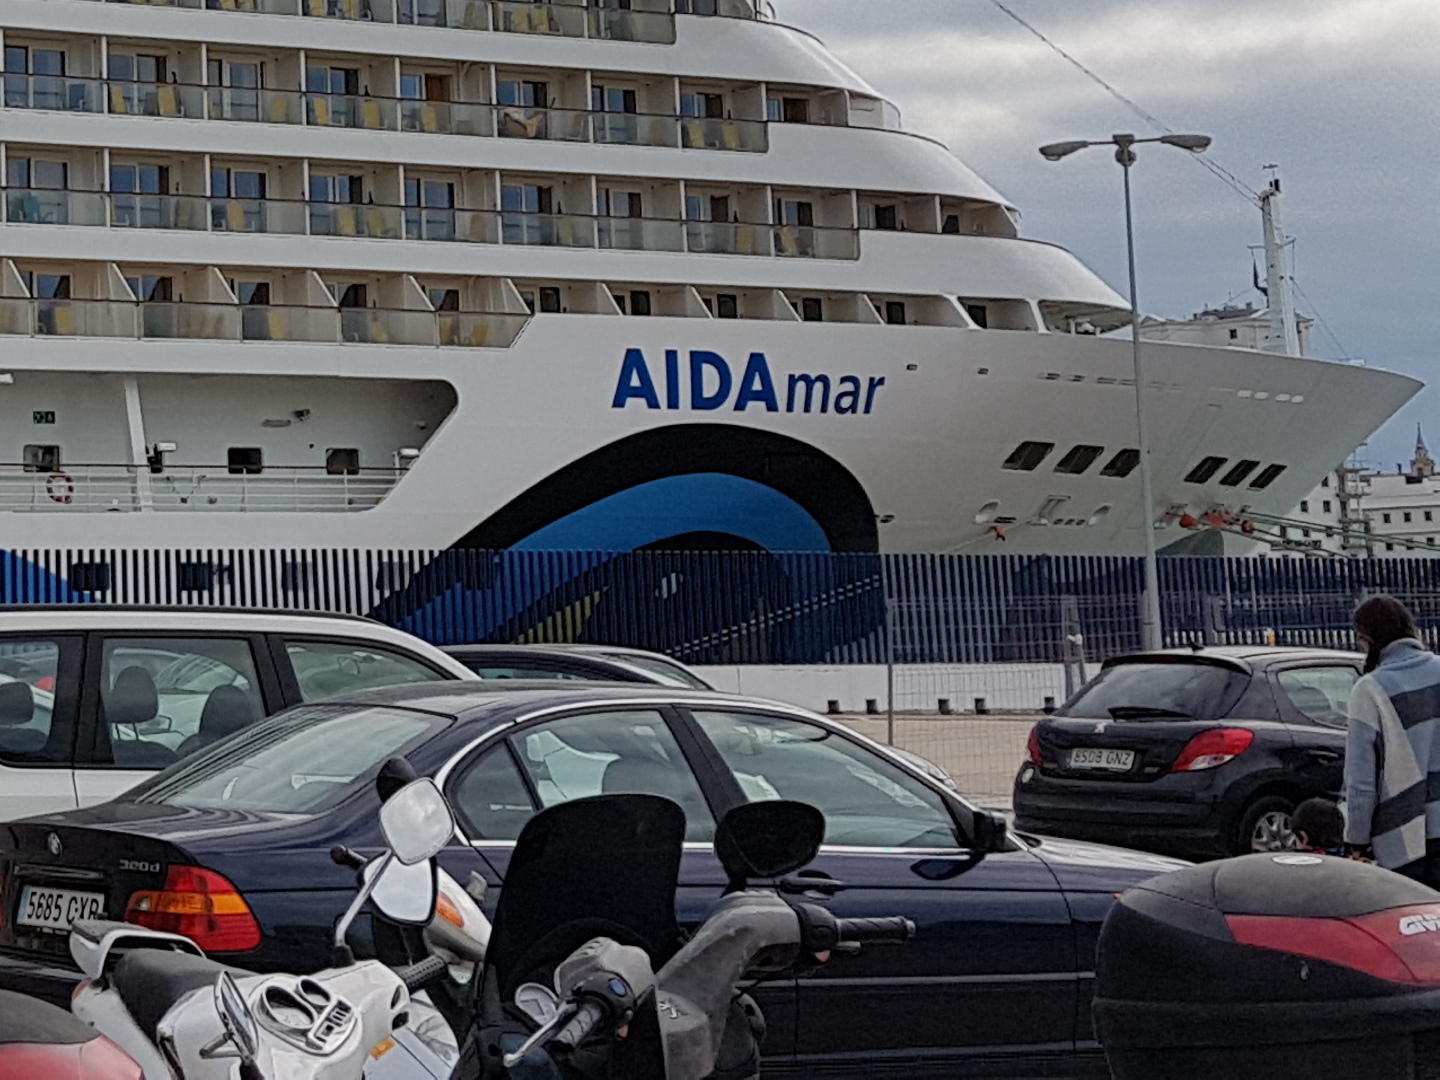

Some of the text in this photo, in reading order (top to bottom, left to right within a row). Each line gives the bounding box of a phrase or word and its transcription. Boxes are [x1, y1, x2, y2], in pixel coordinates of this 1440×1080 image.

[611, 348, 886, 415] AIDAmar
[1105, 751, 1131, 766] GNZ
[26, 891, 64, 922] 5685
